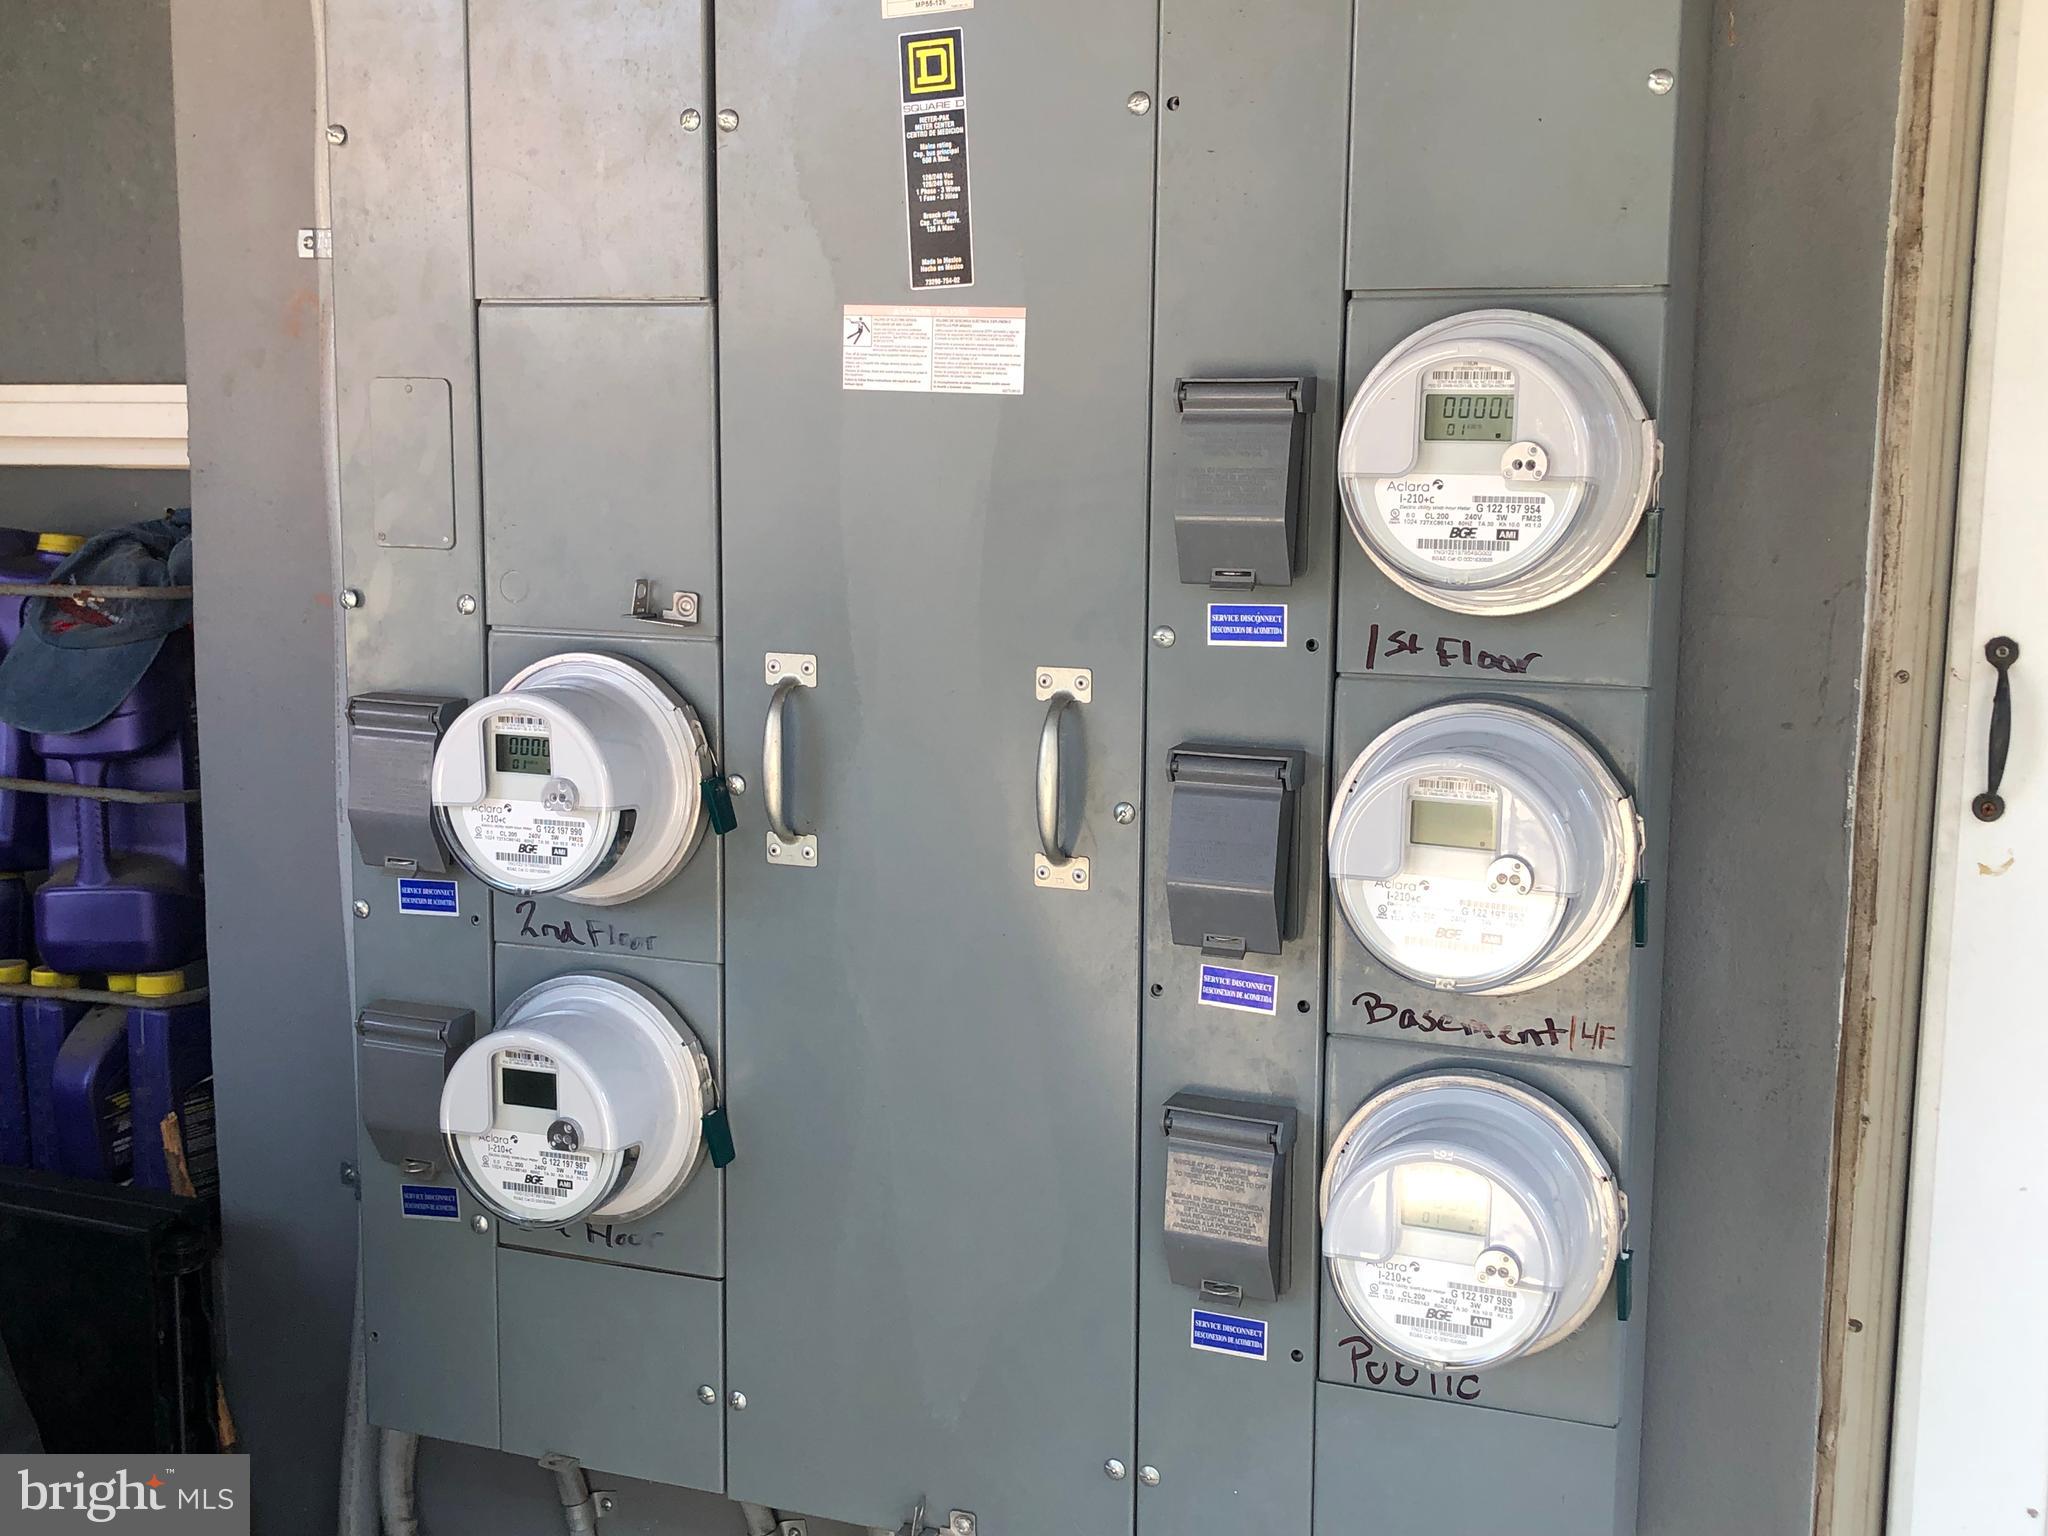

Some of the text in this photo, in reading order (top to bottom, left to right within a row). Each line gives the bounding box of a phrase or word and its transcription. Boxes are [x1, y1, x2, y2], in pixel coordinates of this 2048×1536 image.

[903, 99, 965, 113] SQUARE D
[919, 114, 950, 123] METER-PAK
[914, 120, 955, 131] METER CENTER
[906, 130, 928, 139] CENTRO
[929, 129, 936, 137] DE
[921, 187, 937, 195] Phase
[923, 194, 936, 202] Fase
[922, 210, 957, 220] Branch rating
[921, 258, 936, 266] Made
[943, 256, 962, 264] Mexico
[920, 265, 937, 273] Hecho
[1387, 481, 1429, 492] Aclara
[1476, 503, 1541, 514] G 122 197 954
[1449, 527, 1517, 540] BGE AMI
[1212, 614, 1282, 623] SERVICE DISCONNECT
[1246, 626, 1253, 634] DE
[1253, 627, 1282, 635] ACOMETIDA
[1435, 637, 1543, 674] Floor
[471, 804, 502, 814] Aclara
[535, 825, 542, 833] G
[544, 825, 555, 834] 122
[557, 826, 569, 835] 197
[570, 827, 583, 836] 990
[518, 843, 538, 855] BGE
[553, 848, 567, 856] AMI
[1374, 879, 1417, 891] Aclara
[422, 888, 454, 896] DISCONNECT
[1461, 907, 1469, 916] G
[1472, 908, 1487, 918] 122
[515, 900, 586, 946] 2nd
[1435, 927, 1463, 940] BGE
[1203, 975, 1272, 992] SERVICE DISCONNECT
[1243, 992, 1272, 1004] ACOMETIDA
[541, 1157, 548, 1165] G
[549, 1158, 560, 1167] 122
[562, 1160, 573, 1168] 197
[575, 1161, 587, 1170] 987
[524, 1173, 544, 1186] BGE
[558, 1180, 572, 1188] AMI
[1451, 1289, 1458, 1298] G
[1461, 1291, 1476, 1301] 122
[1479, 1293, 1494, 1303] 197
[1402, 1291, 1412, 1299] CL
[1413, 1292, 1426, 1300] 200
[1494, 1305, 1513, 1314] FM2S
[1426, 1308, 1453, 1321] BGE
[1472, 1318, 1489, 1327] AMI
[1195, 1319, 1263, 1338] SERVICE DISCONNECT
[1234, 1337, 1263, 1349] ACOMETIDA
